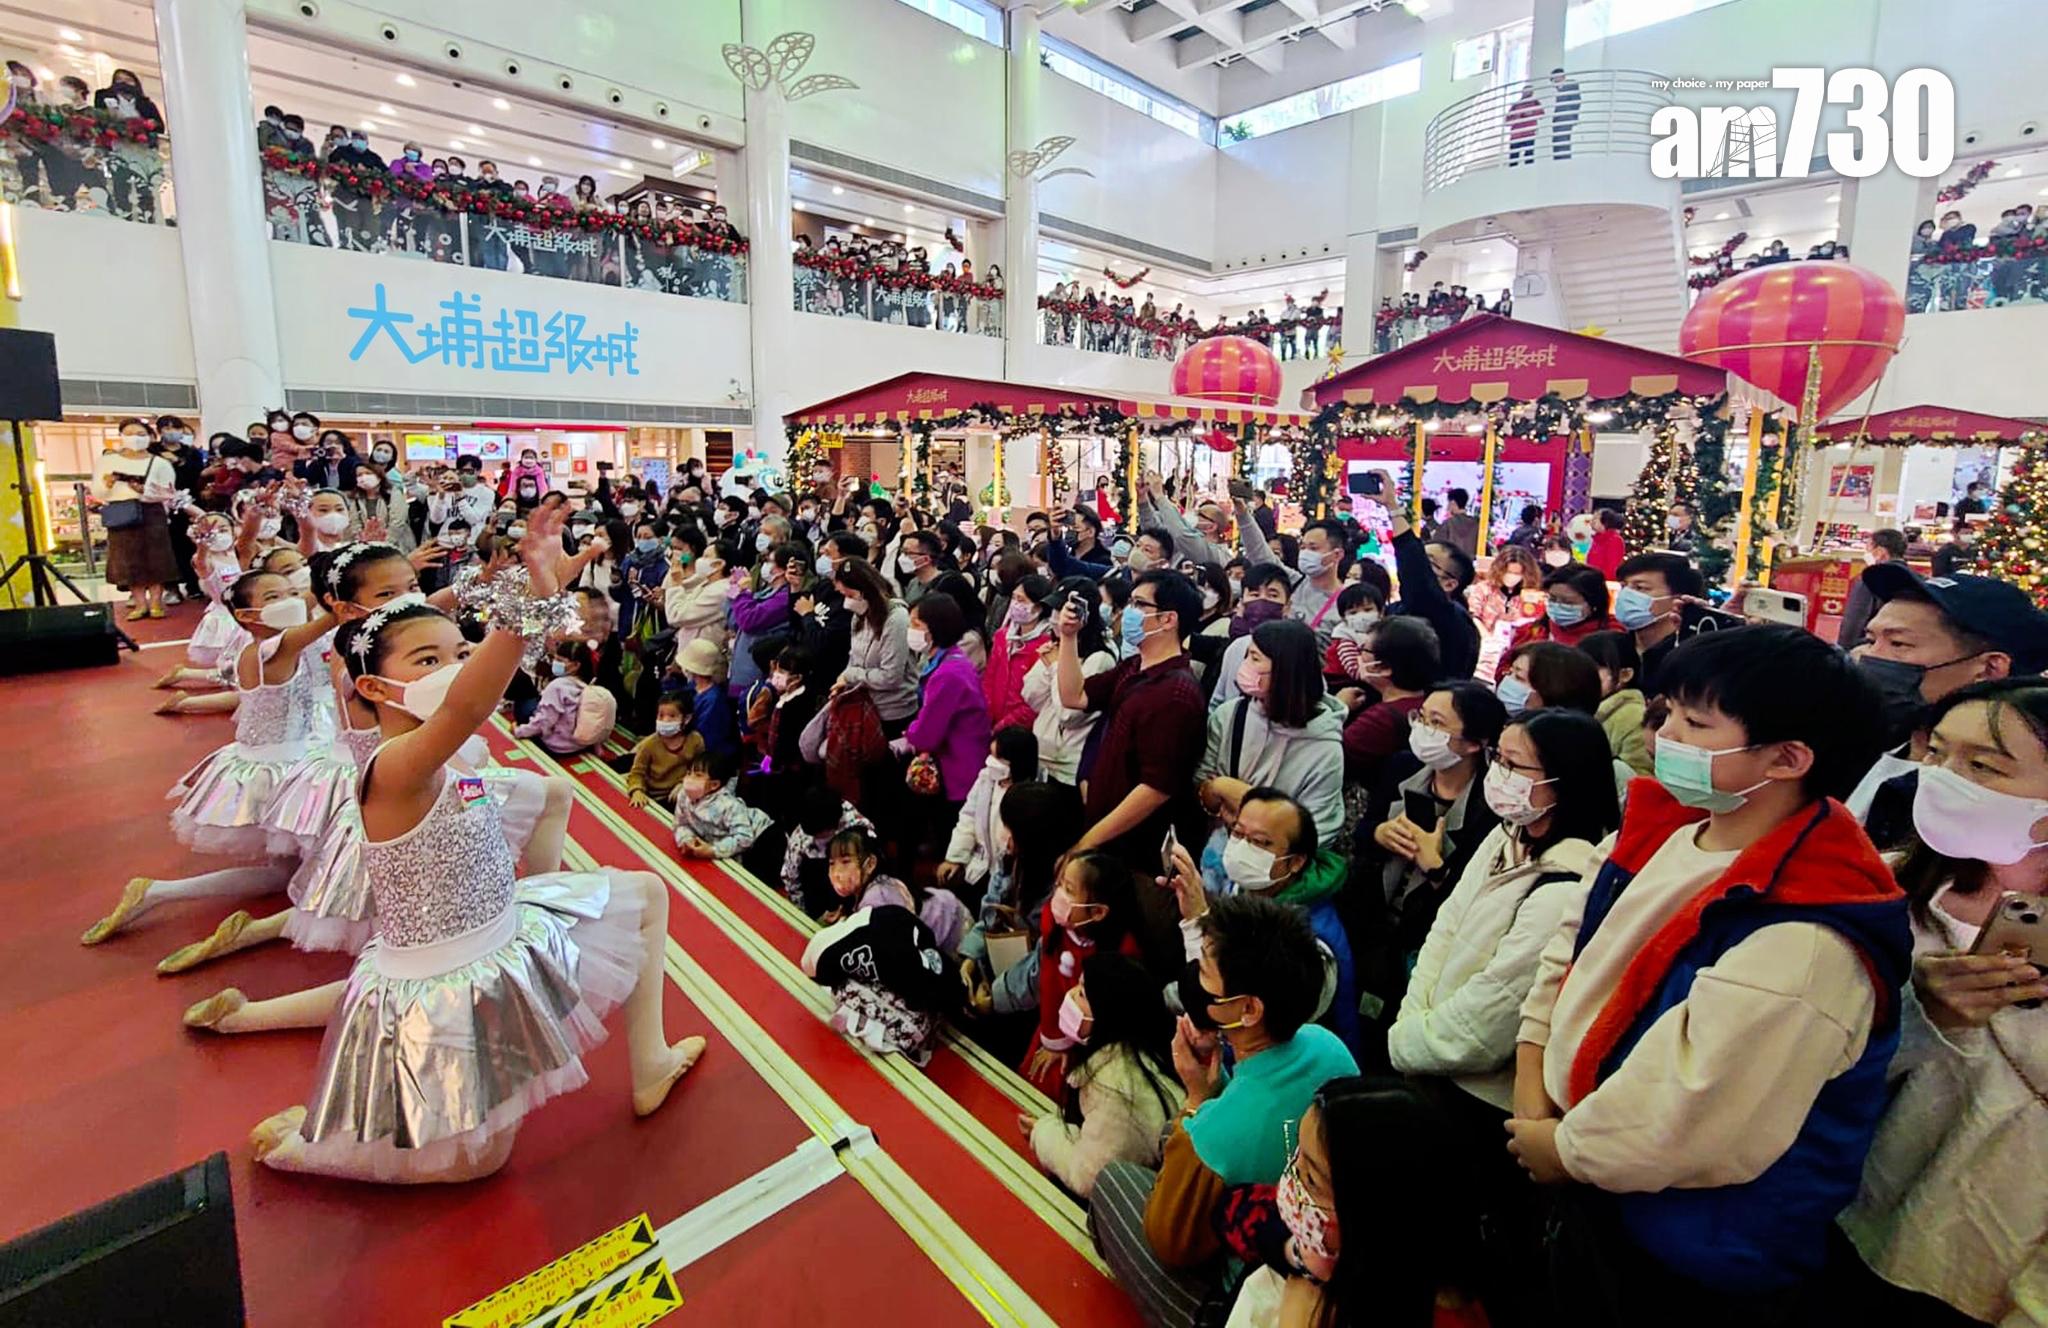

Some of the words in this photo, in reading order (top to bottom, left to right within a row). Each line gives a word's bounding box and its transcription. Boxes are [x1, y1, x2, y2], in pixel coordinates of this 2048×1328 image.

[347, 283, 640, 376] 大埔超級城
[1433, 343, 1558, 373] 大埔超級城
